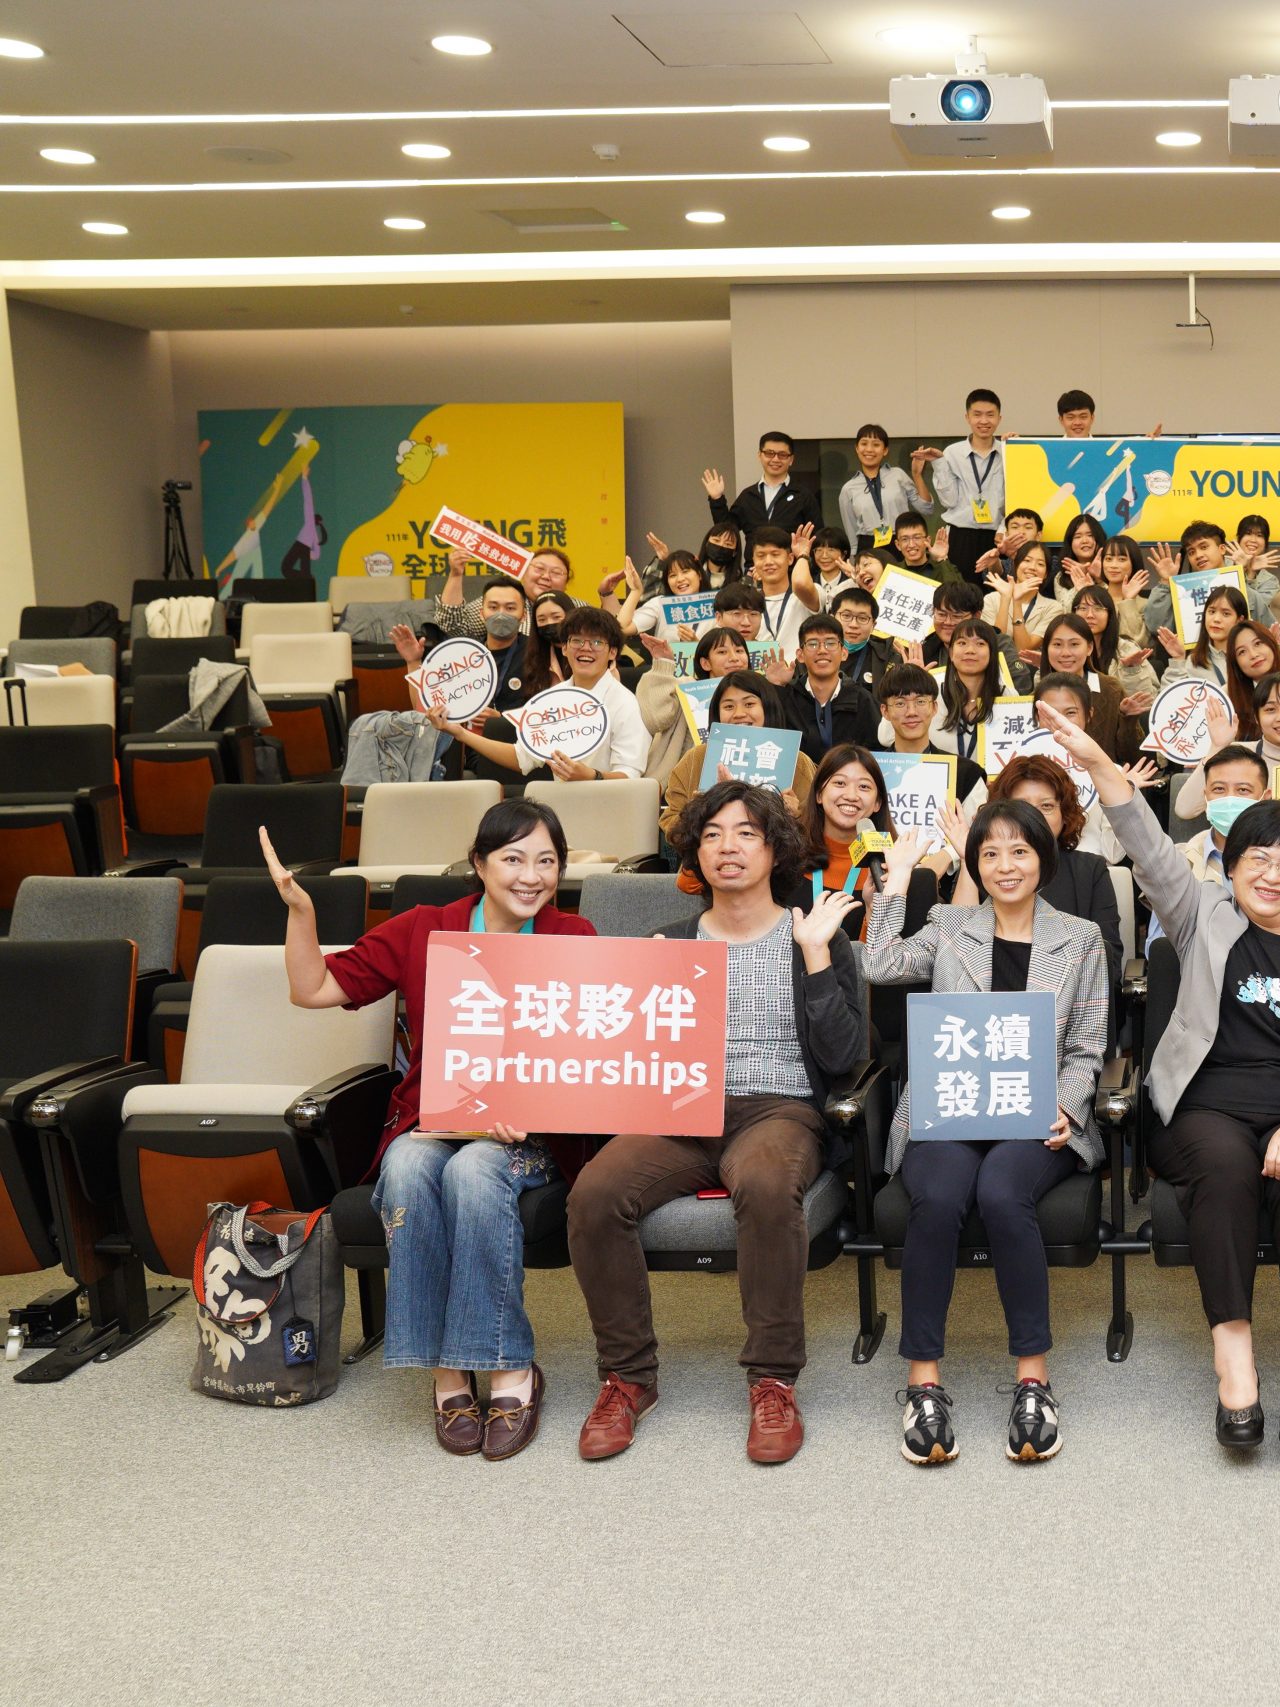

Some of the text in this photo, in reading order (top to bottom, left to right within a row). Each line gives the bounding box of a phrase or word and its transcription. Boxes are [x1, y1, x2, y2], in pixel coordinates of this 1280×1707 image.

[409, 518, 567, 550] YNG飛
[879, 606, 923, 632] 及生產
[550, 724, 602, 744] ACTION
[720, 738, 783, 770] 社會
[887, 793, 937, 809] AKE A
[890, 810, 935, 826] RCLE
[448, 979, 697, 1041] 全球夥伴
[933, 1013, 1032, 1061] 永續
[444, 1049, 708, 1095] Partnerships
[934, 1070, 1032, 1118] 發展
[973, 1253, 988, 1261] A10
[292, 1331, 310, 1354] 男
